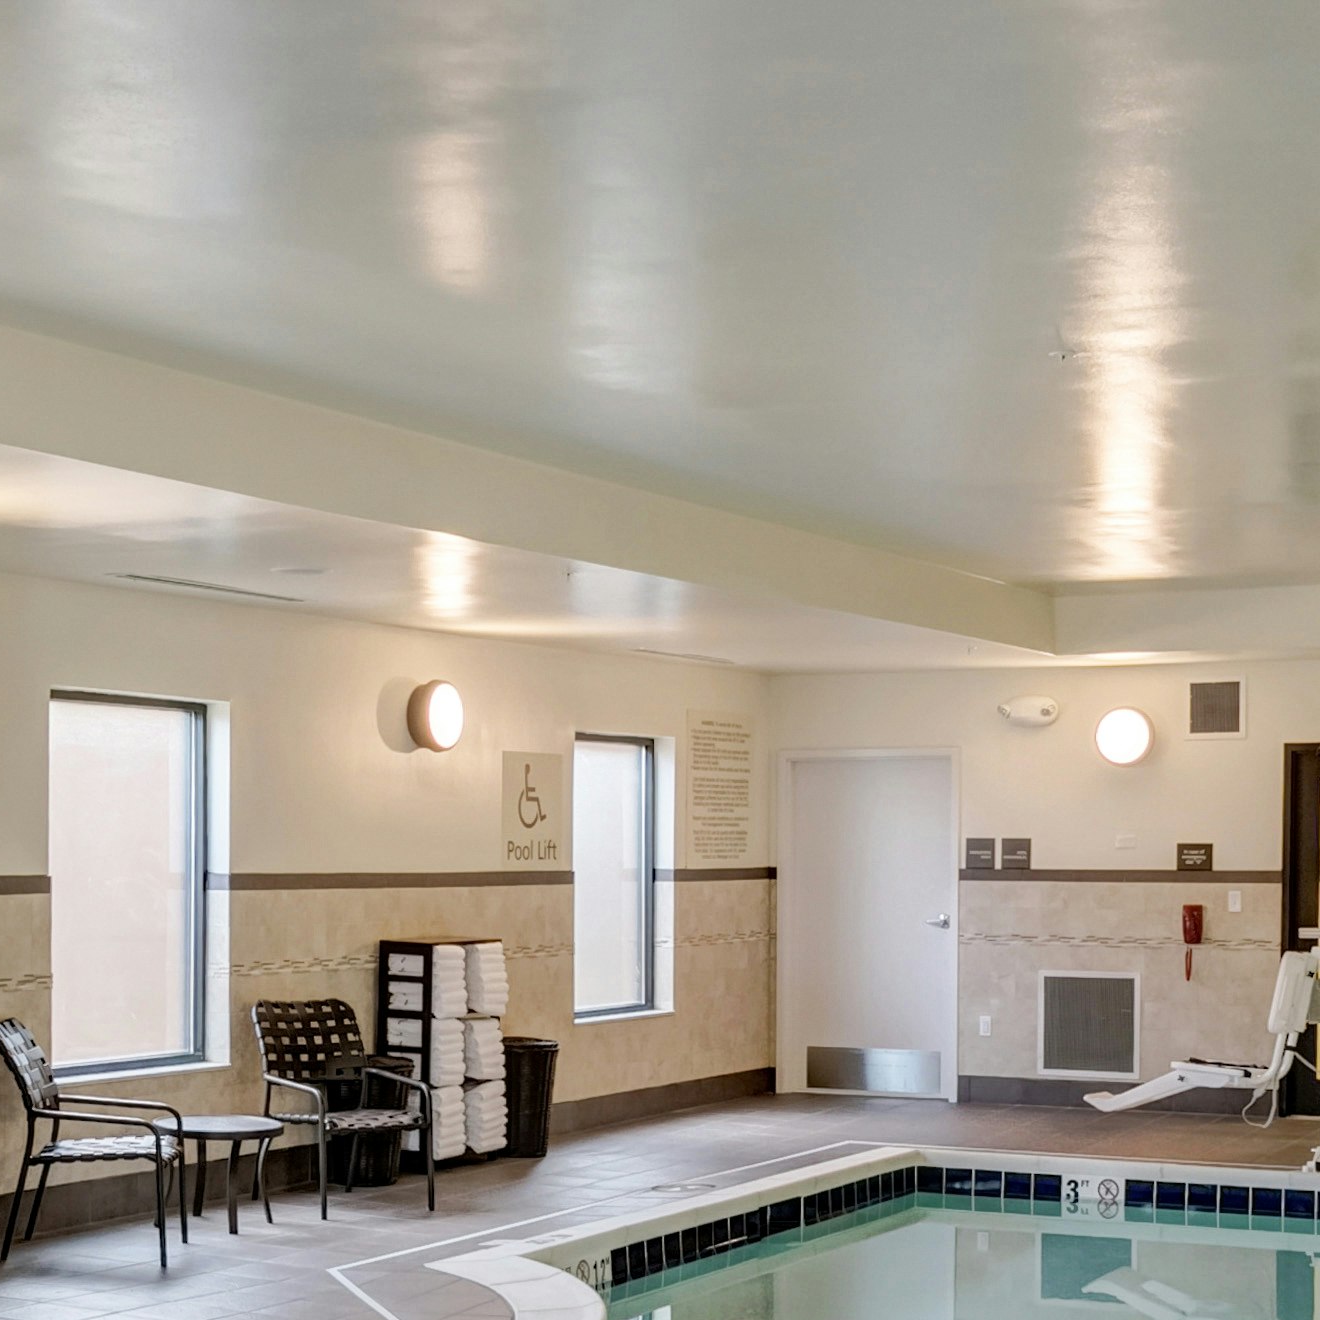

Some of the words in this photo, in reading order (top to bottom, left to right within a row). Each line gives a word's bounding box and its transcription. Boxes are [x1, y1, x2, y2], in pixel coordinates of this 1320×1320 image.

[507, 840, 533, 861] Pool
[538, 839, 557, 861] Lift
[1066, 1179, 1079, 1202] 3
[1080, 1179, 1090, 1187] FT
